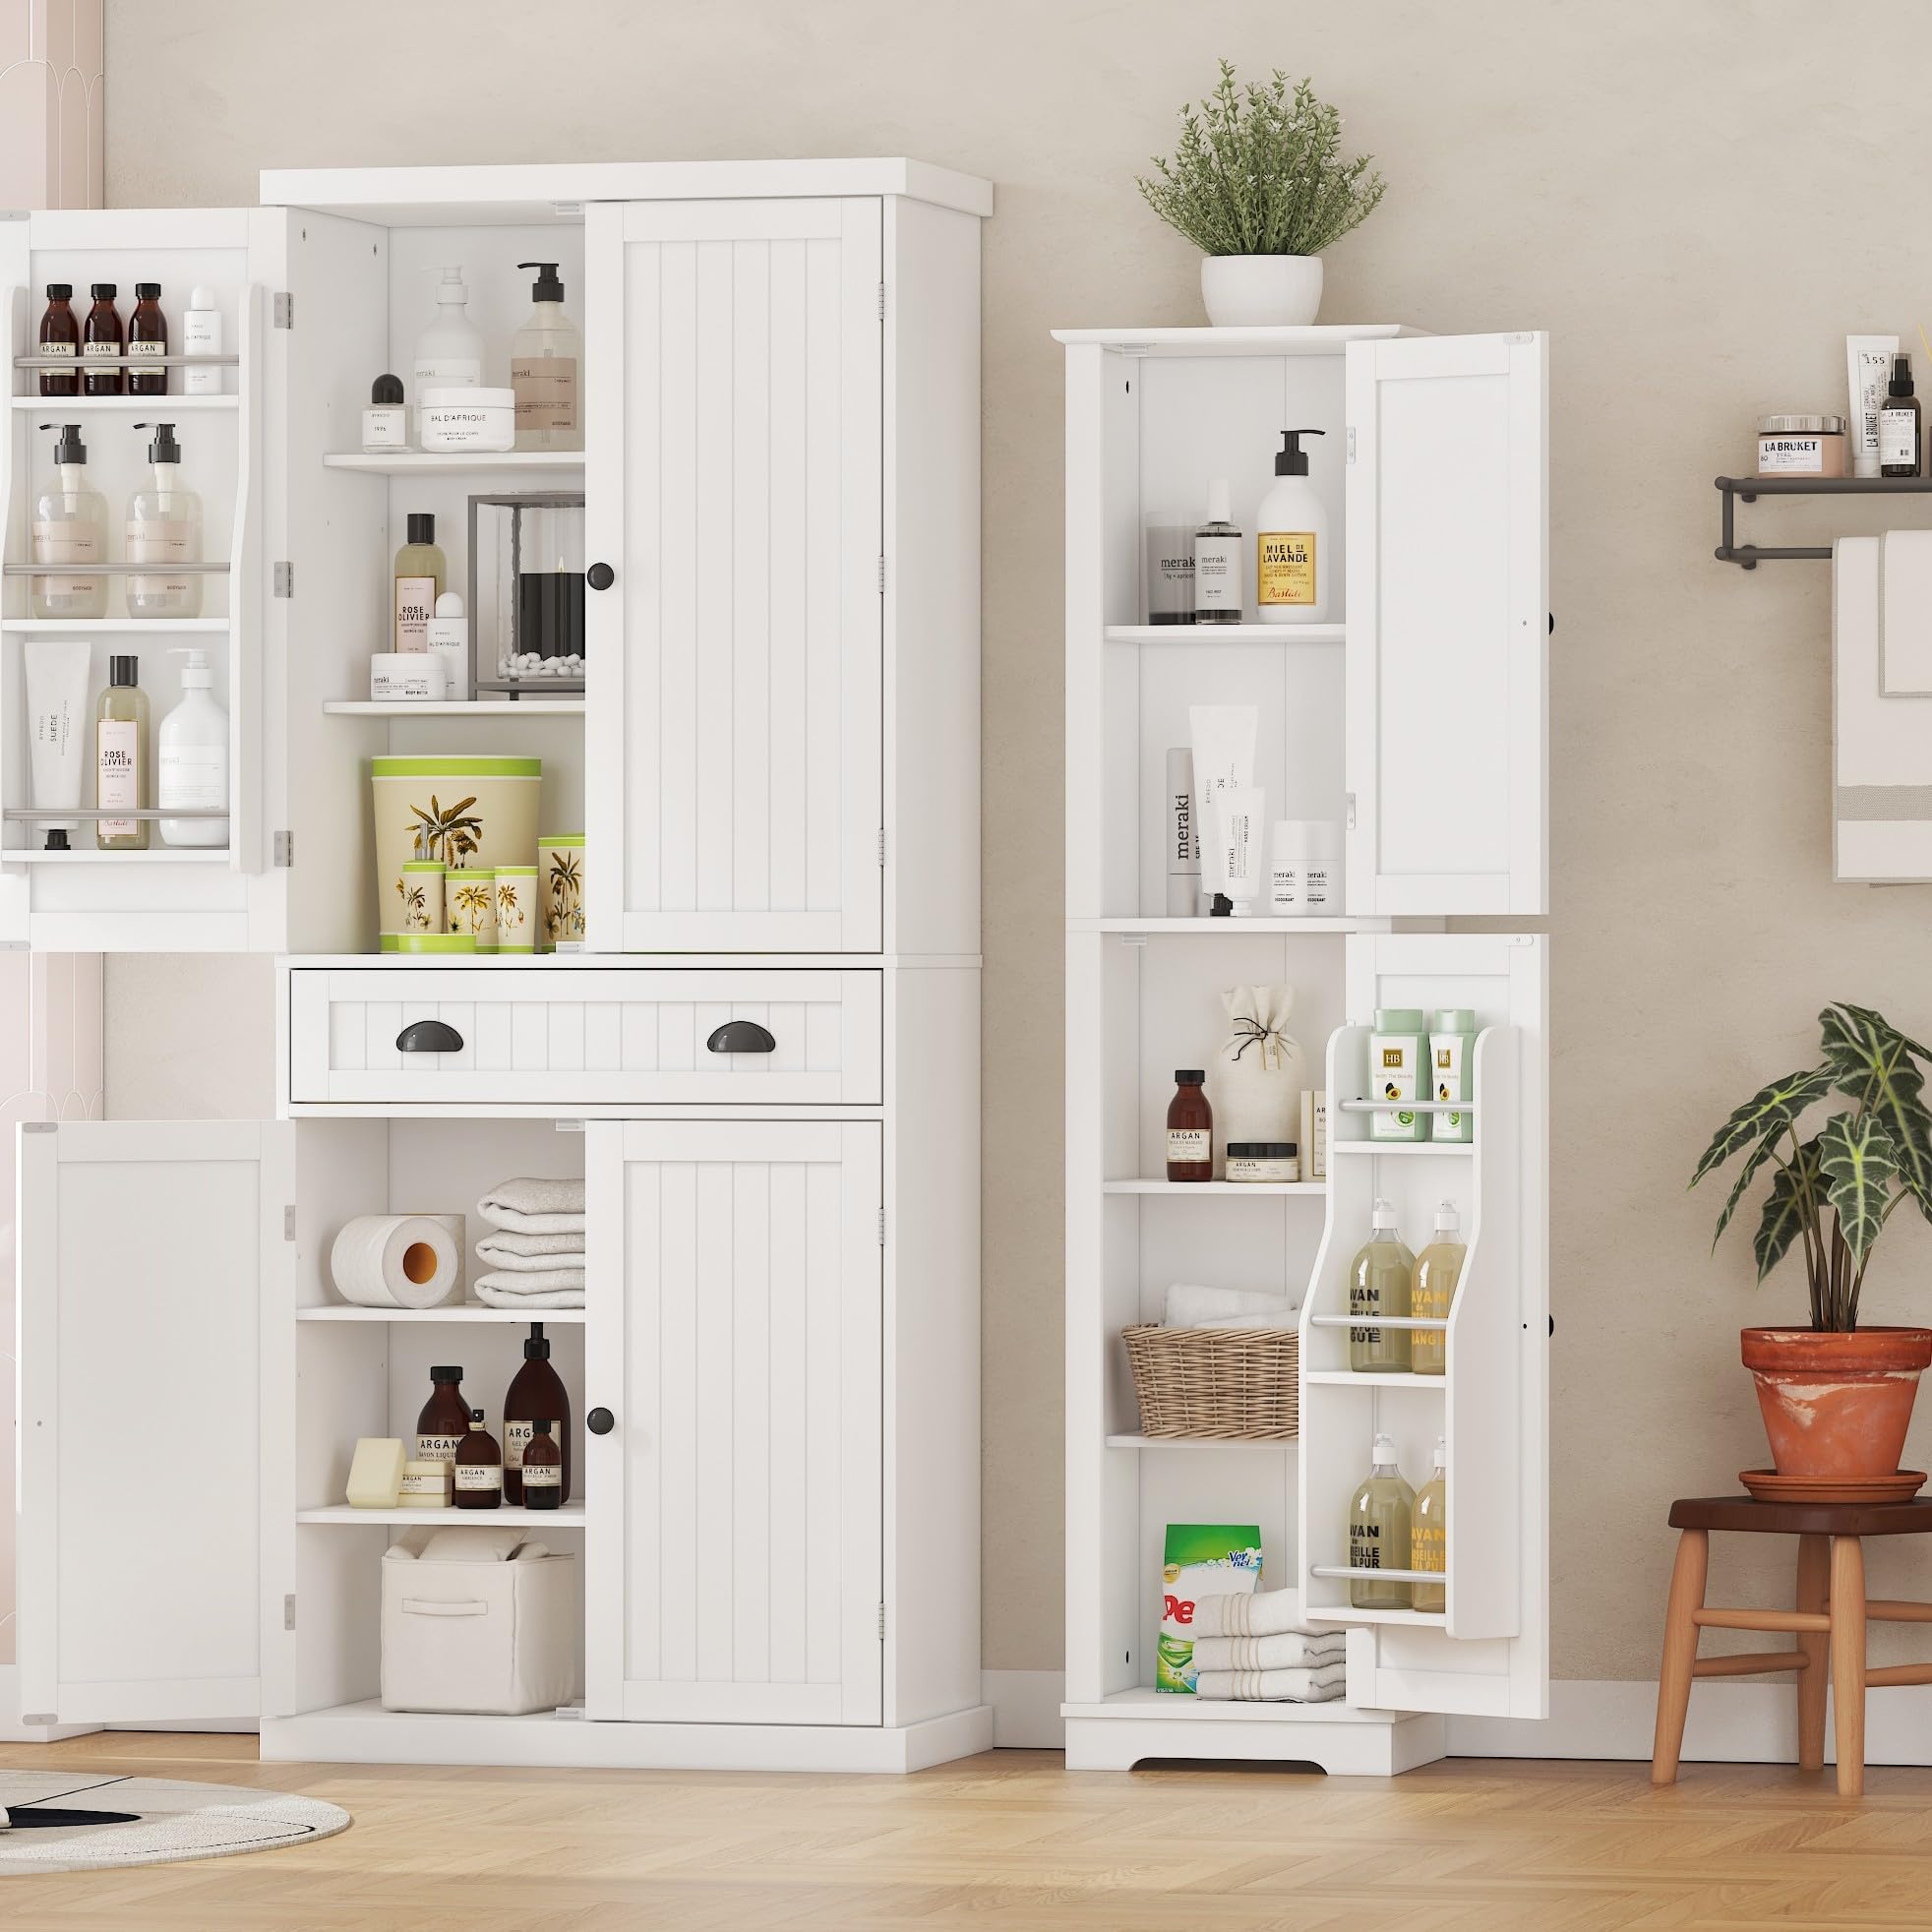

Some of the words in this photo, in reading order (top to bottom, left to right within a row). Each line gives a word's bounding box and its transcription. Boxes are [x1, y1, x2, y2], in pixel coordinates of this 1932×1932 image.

[1865, 412, 1878, 435] BRUKET
[1778, 441, 1818, 452] BRUKET
[1266, 544, 1294, 554] MIEL
[1161, 557, 1195, 568] merak
[1201, 555, 1227, 564] meraki
[1263, 554, 1308, 563] LAVANDE
[1175, 794, 1189, 860] meraki
[1386, 1055, 1400, 1063] HB
[509, 1427, 535, 1438] ARG
[421, 1439, 459, 1449] ARGAN
